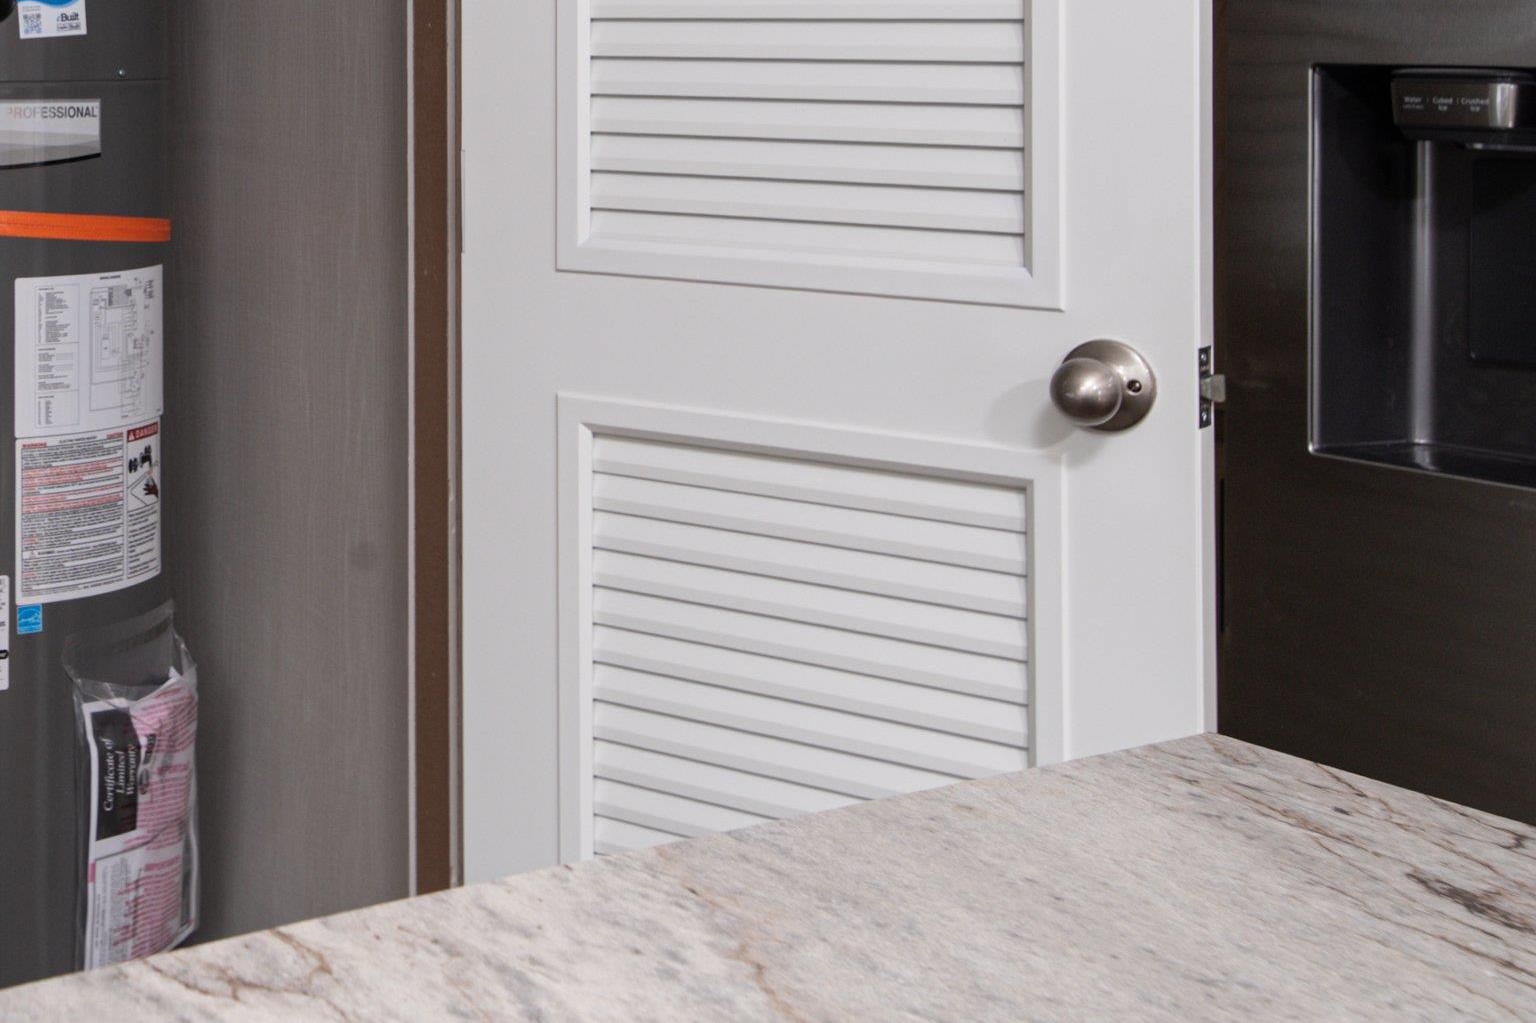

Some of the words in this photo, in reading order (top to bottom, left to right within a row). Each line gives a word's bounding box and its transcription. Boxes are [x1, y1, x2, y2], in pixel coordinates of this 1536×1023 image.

[102, 737, 113, 751] of
[103, 755, 116, 812] Certificate
[115, 751, 124, 793] Limited
